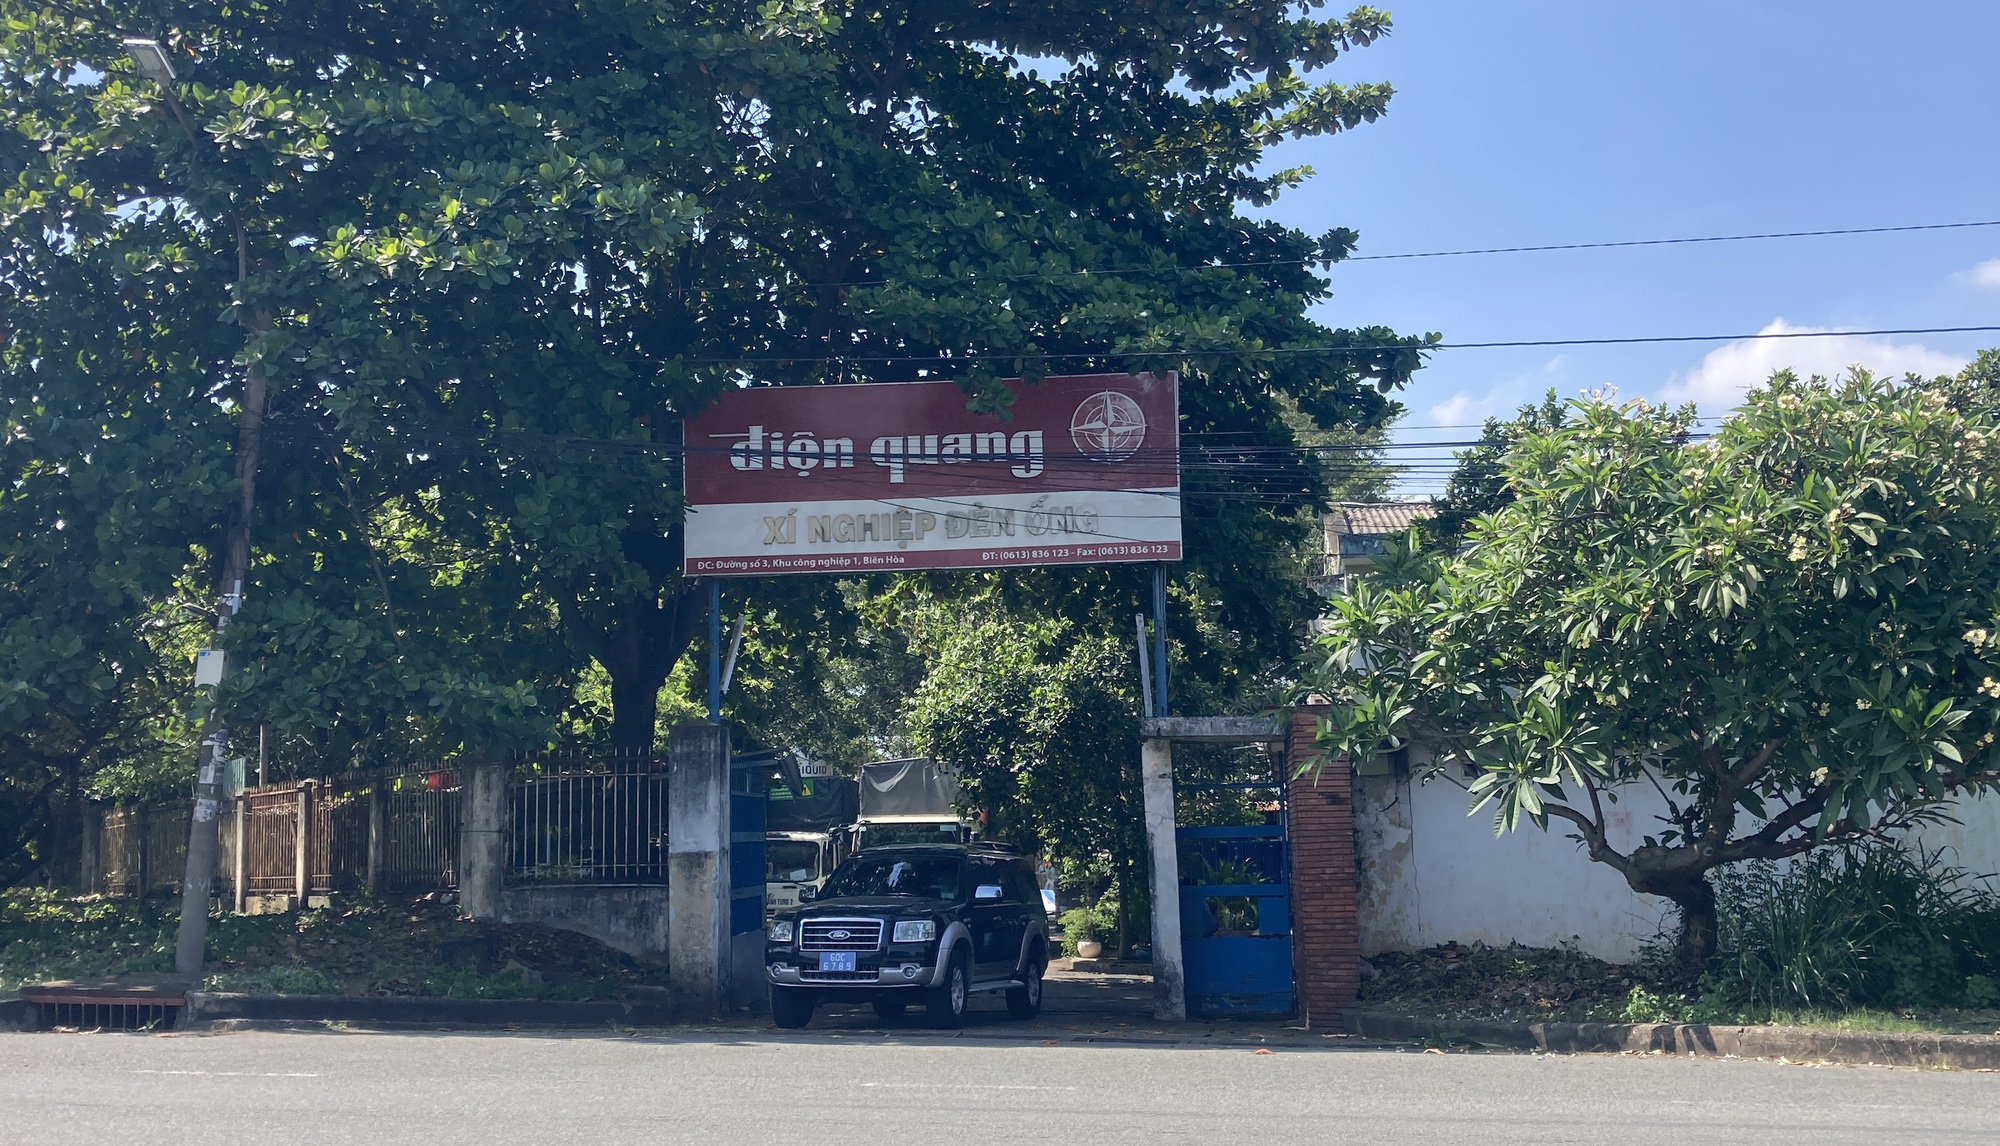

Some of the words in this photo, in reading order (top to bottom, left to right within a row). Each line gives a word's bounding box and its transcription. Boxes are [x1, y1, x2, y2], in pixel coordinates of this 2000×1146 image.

[708, 425, 855, 477] điện
[869, 430, 1044, 484] quang
[763, 508, 797, 545] XÍ
[808, 507, 936, 549] NGHIỆP
[944, 502, 1016, 539] ĐÈN
[1023, 493, 1098, 537] ỐNG
[982, 552, 998, 560] ĐT:
[1000, 550, 1030, 561] (0613)
[1032, 549, 1049, 559] 836
[1052, 549, 1069, 558] 123
[1077, 548, 1096, 557] Fax:
[1098, 545, 1128, 556] (0613)
[1130, 545, 1148, 554] 836
[1151, 545, 1168, 554] 123
[697, 561, 715, 570] ĐC:
[716, 559, 748, 570] Đường
[750, 558, 760, 568] số
[762, 559, 771, 569] 3,
[773, 557, 791, 567] Khu
[793, 557, 816, 569] công
[818, 555, 850, 568] nghiệp
[853, 556, 861, 567] 1,
[863, 554, 884, 565] Biên
[886, 554, 905, 564] Hòa
[801, 765, 827, 775] IQUID
[830, 953, 846, 962] 60C
[823, 962, 852, 971] 6789
